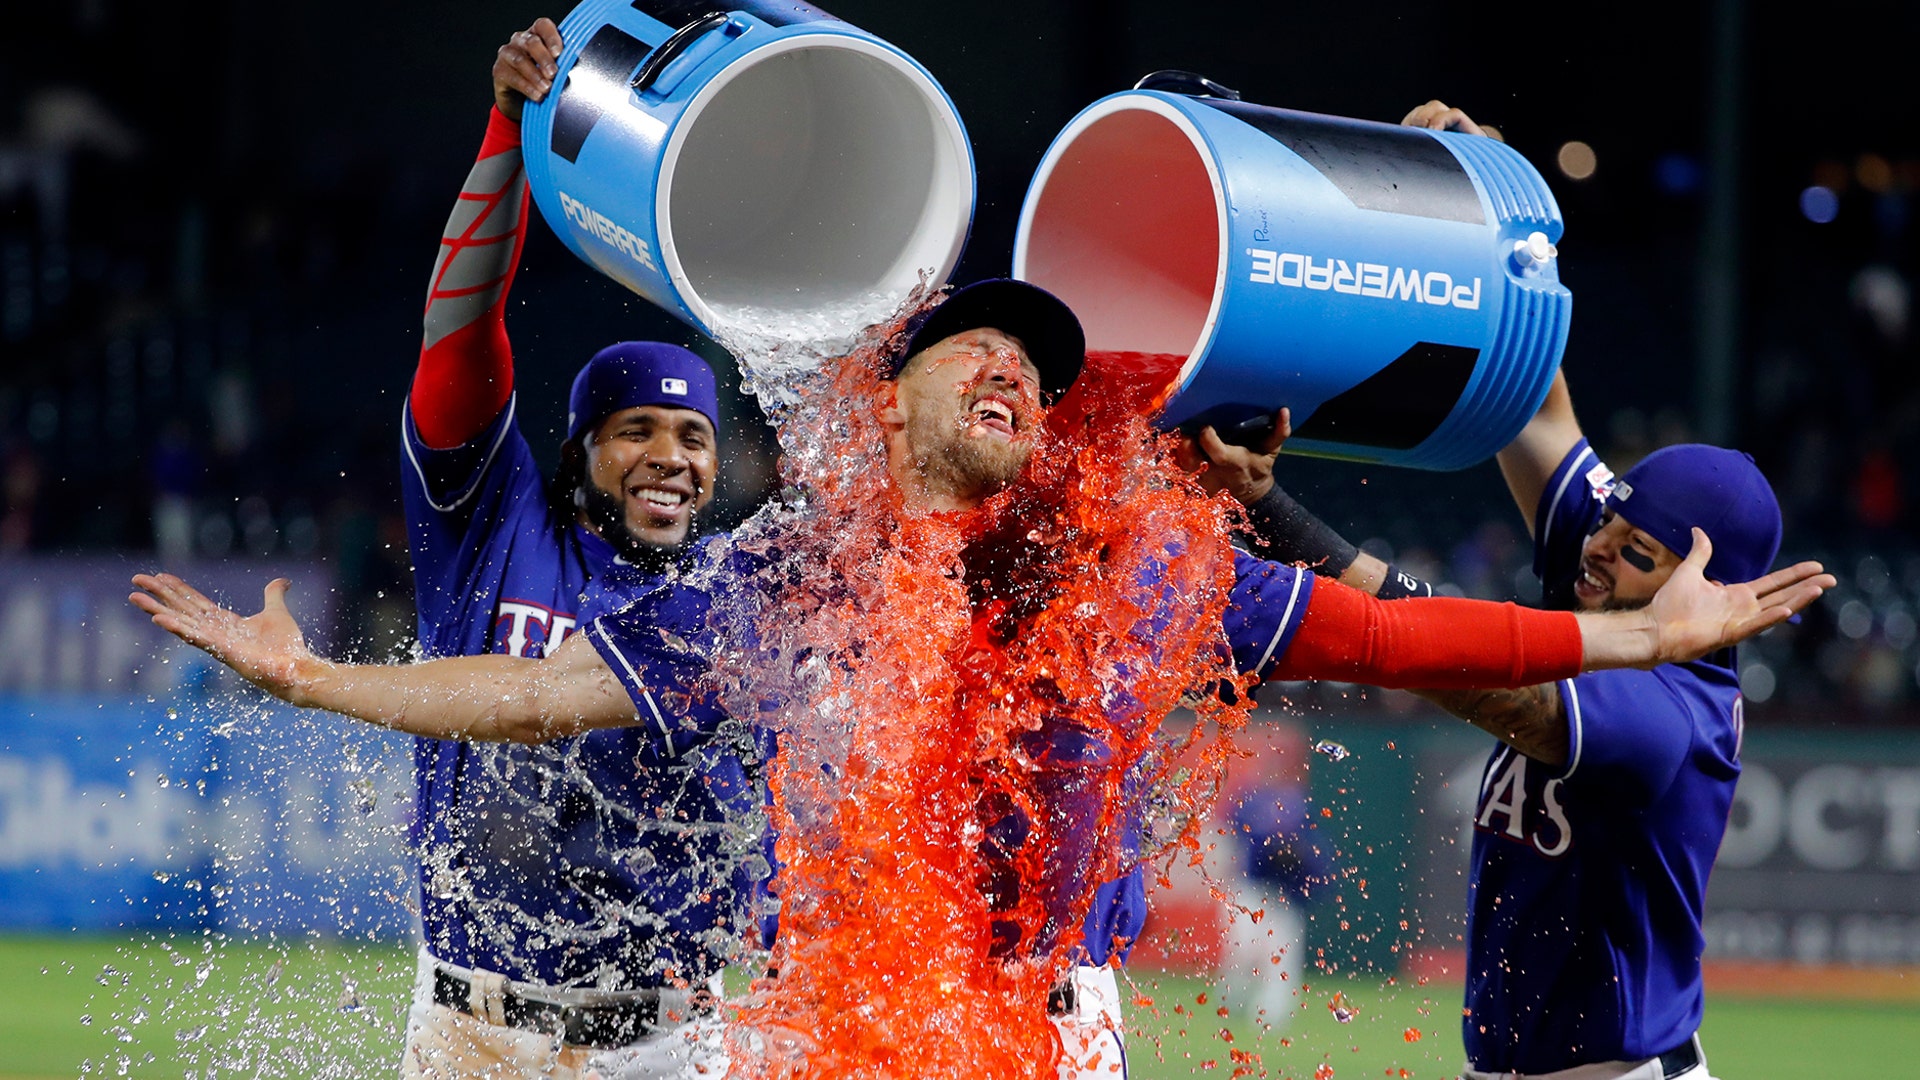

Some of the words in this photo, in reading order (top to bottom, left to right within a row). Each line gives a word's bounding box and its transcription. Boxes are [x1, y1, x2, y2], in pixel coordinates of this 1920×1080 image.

[559, 190, 658, 273] POWERADE
[1248, 247, 1482, 310] POWERADE
[1477, 752, 1573, 857] AS
